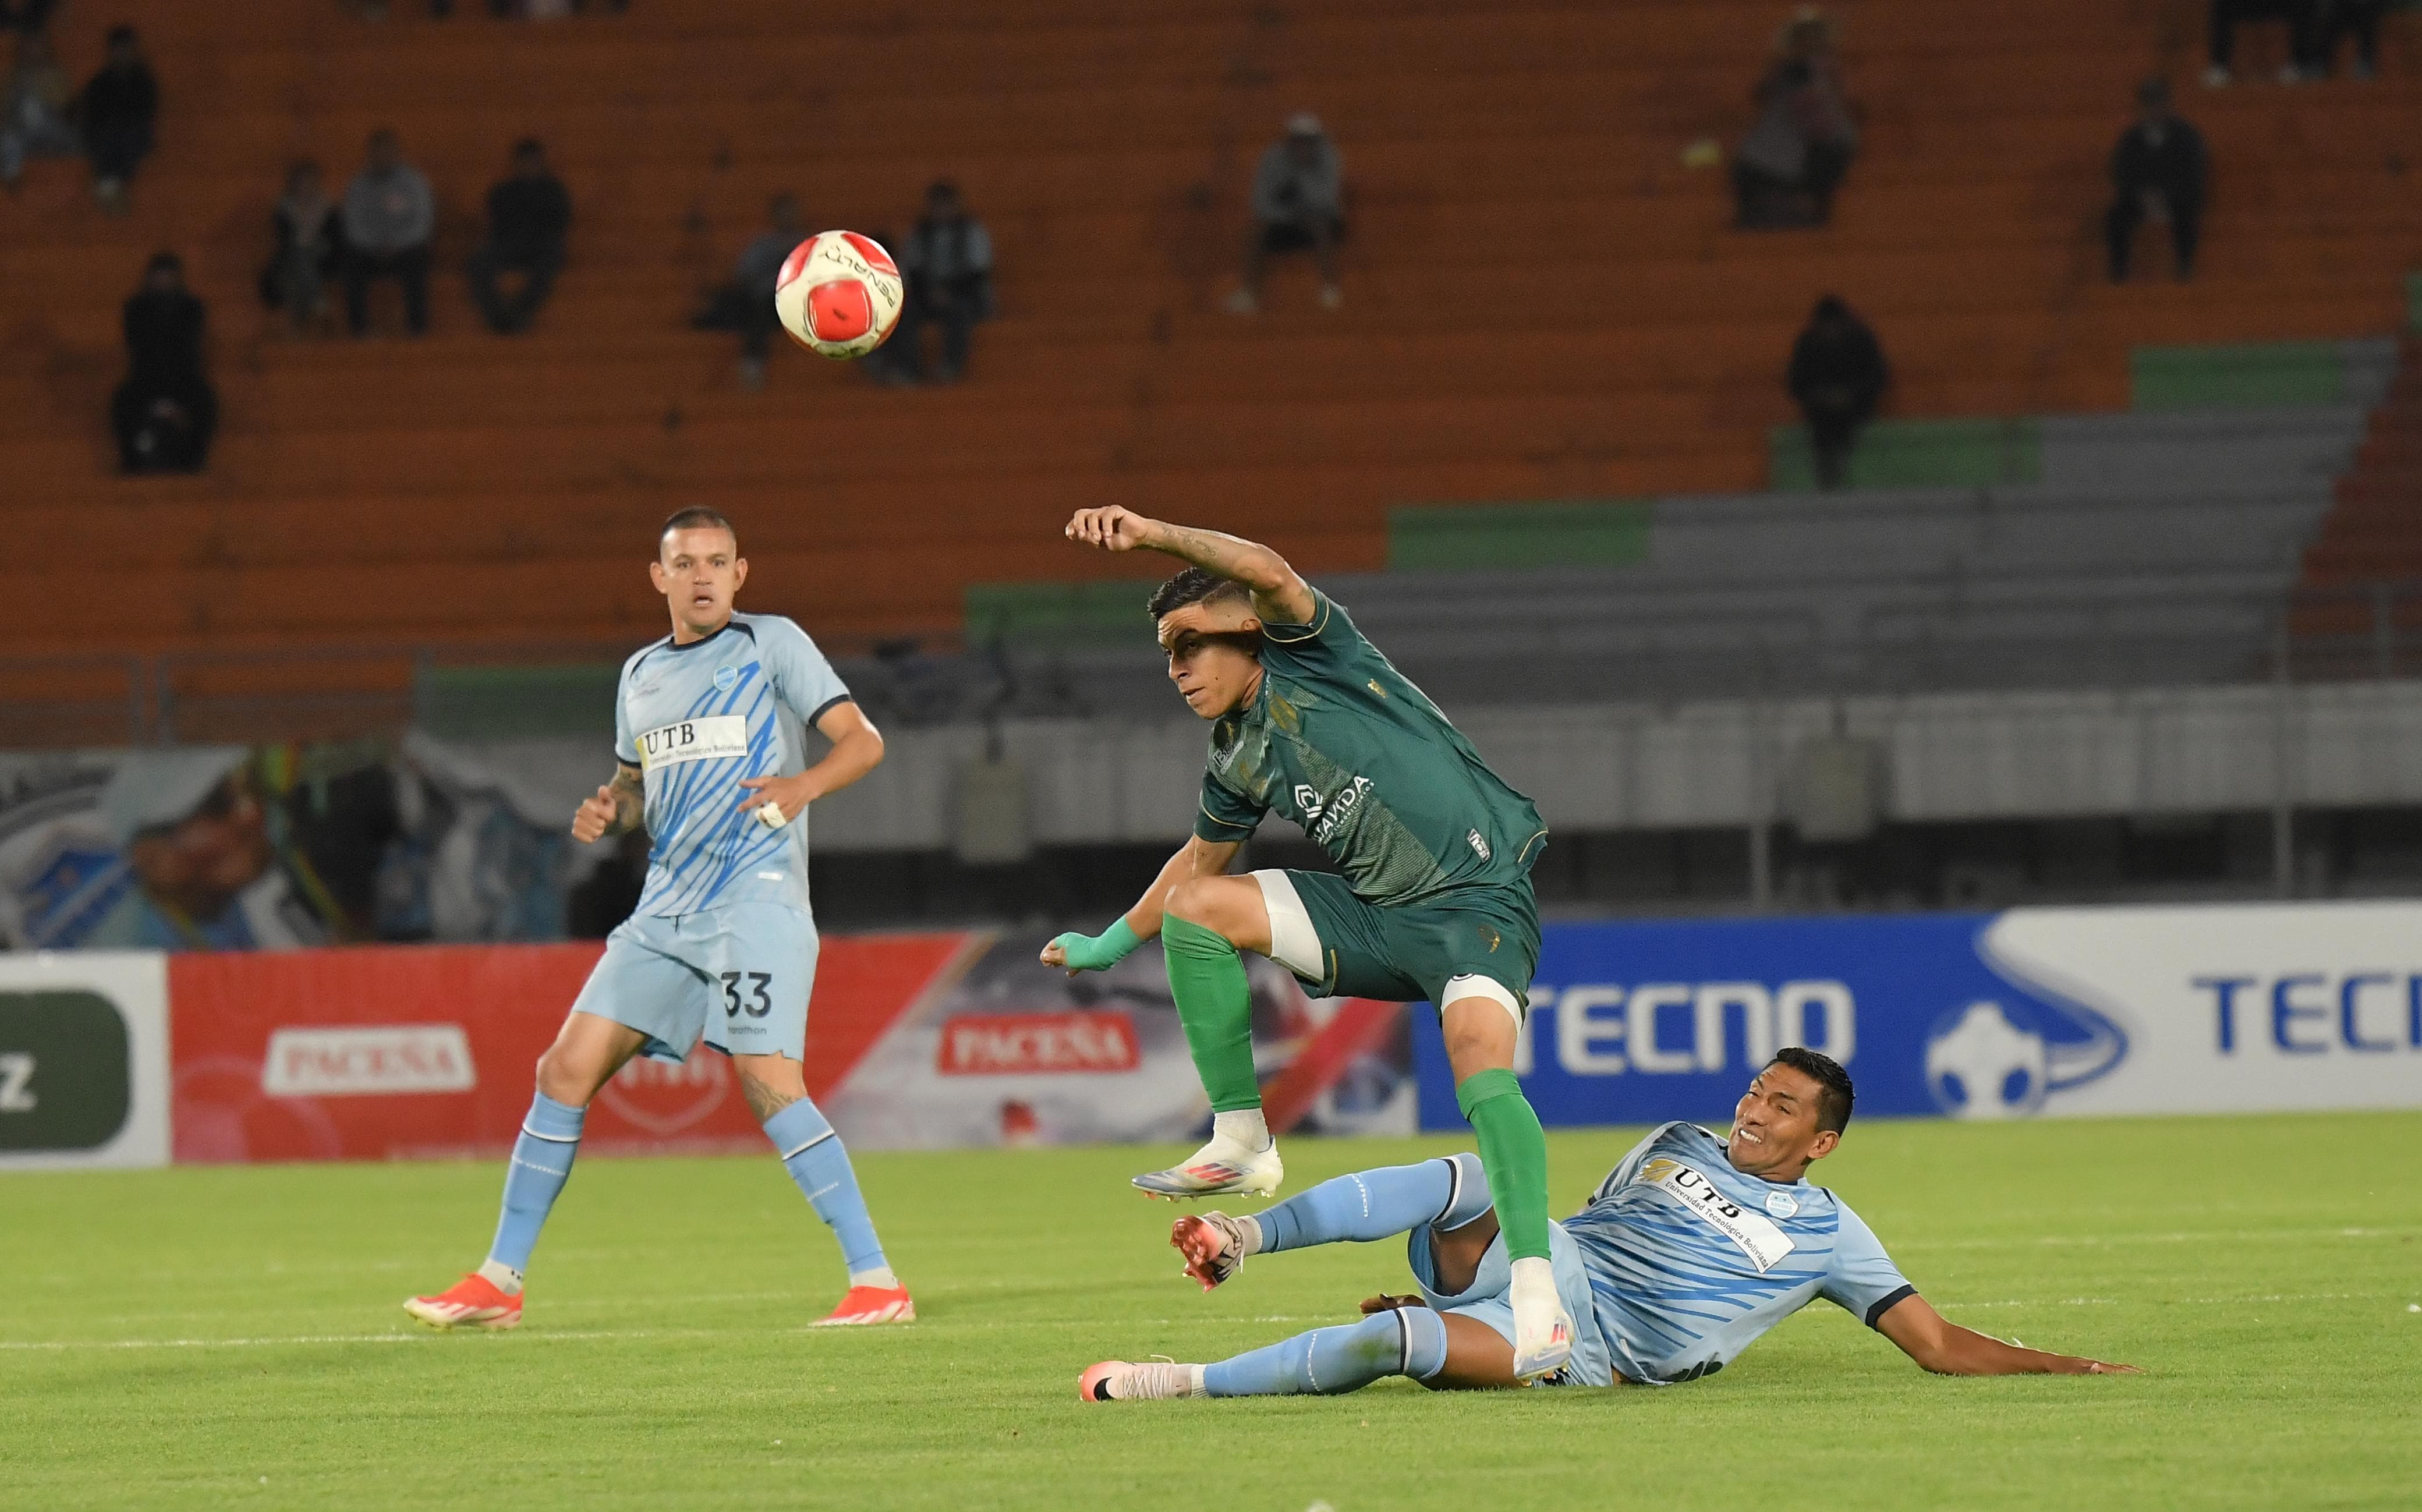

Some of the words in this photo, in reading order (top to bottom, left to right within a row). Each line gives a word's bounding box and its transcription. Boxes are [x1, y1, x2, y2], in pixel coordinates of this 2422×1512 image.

[819, 245, 895, 307] PENALTY
[645, 723, 695, 755] UTB
[720, 971, 772, 1018] 33
[2190, 971, 2422, 1055] TEC
[1513, 980, 1856, 1076] TECNO
[1674, 1167, 1743, 1219] UTB
[1665, 1181, 1706, 1212] Universidad
[1705, 1208, 1745, 1241] Tecnológica
[1743, 1238, 1770, 1270] Boliviana
